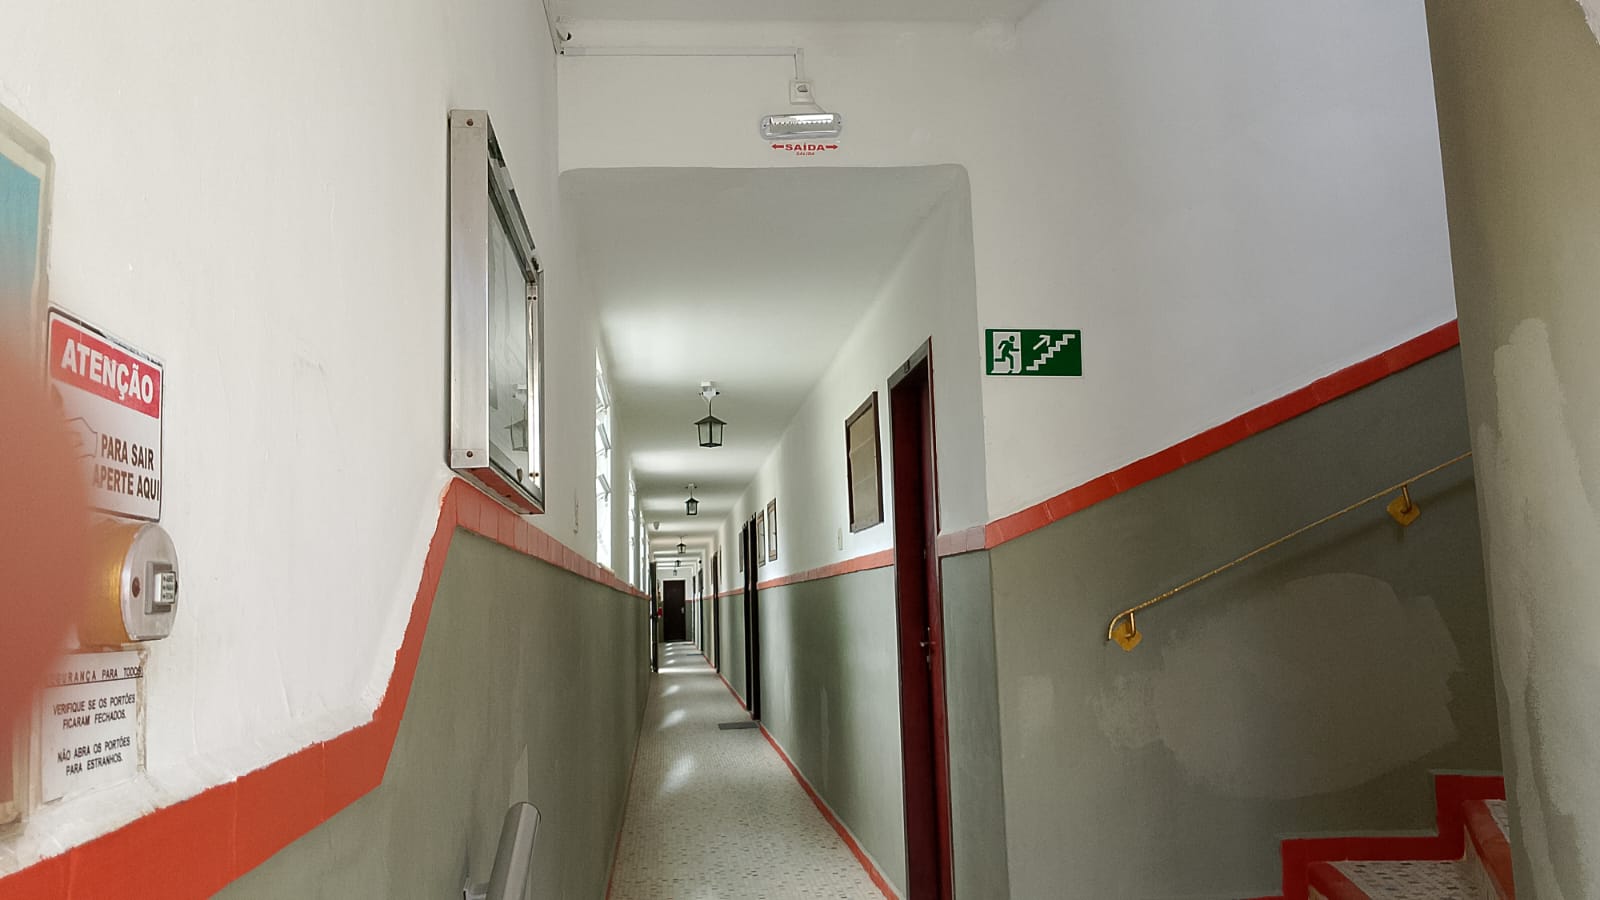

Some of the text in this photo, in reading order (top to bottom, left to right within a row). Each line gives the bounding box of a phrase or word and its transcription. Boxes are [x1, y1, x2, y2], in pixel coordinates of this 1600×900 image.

[785, 142, 825, 151] SAÍDA
[61, 338, 154, 404] ATENÇÃO
[101, 434, 154, 471] PARA SAIR
[92, 463, 160, 501] APERTE AQUI
[101, 668, 118, 679] PARA
[53, 692, 136, 716] VERIFIQUE SE OS PORTÕES
[62, 715, 91, 730] FICARAM
[57, 735, 131, 763] NÃO ABRA OS PORTÕES
[65, 762, 82, 776] PARA
